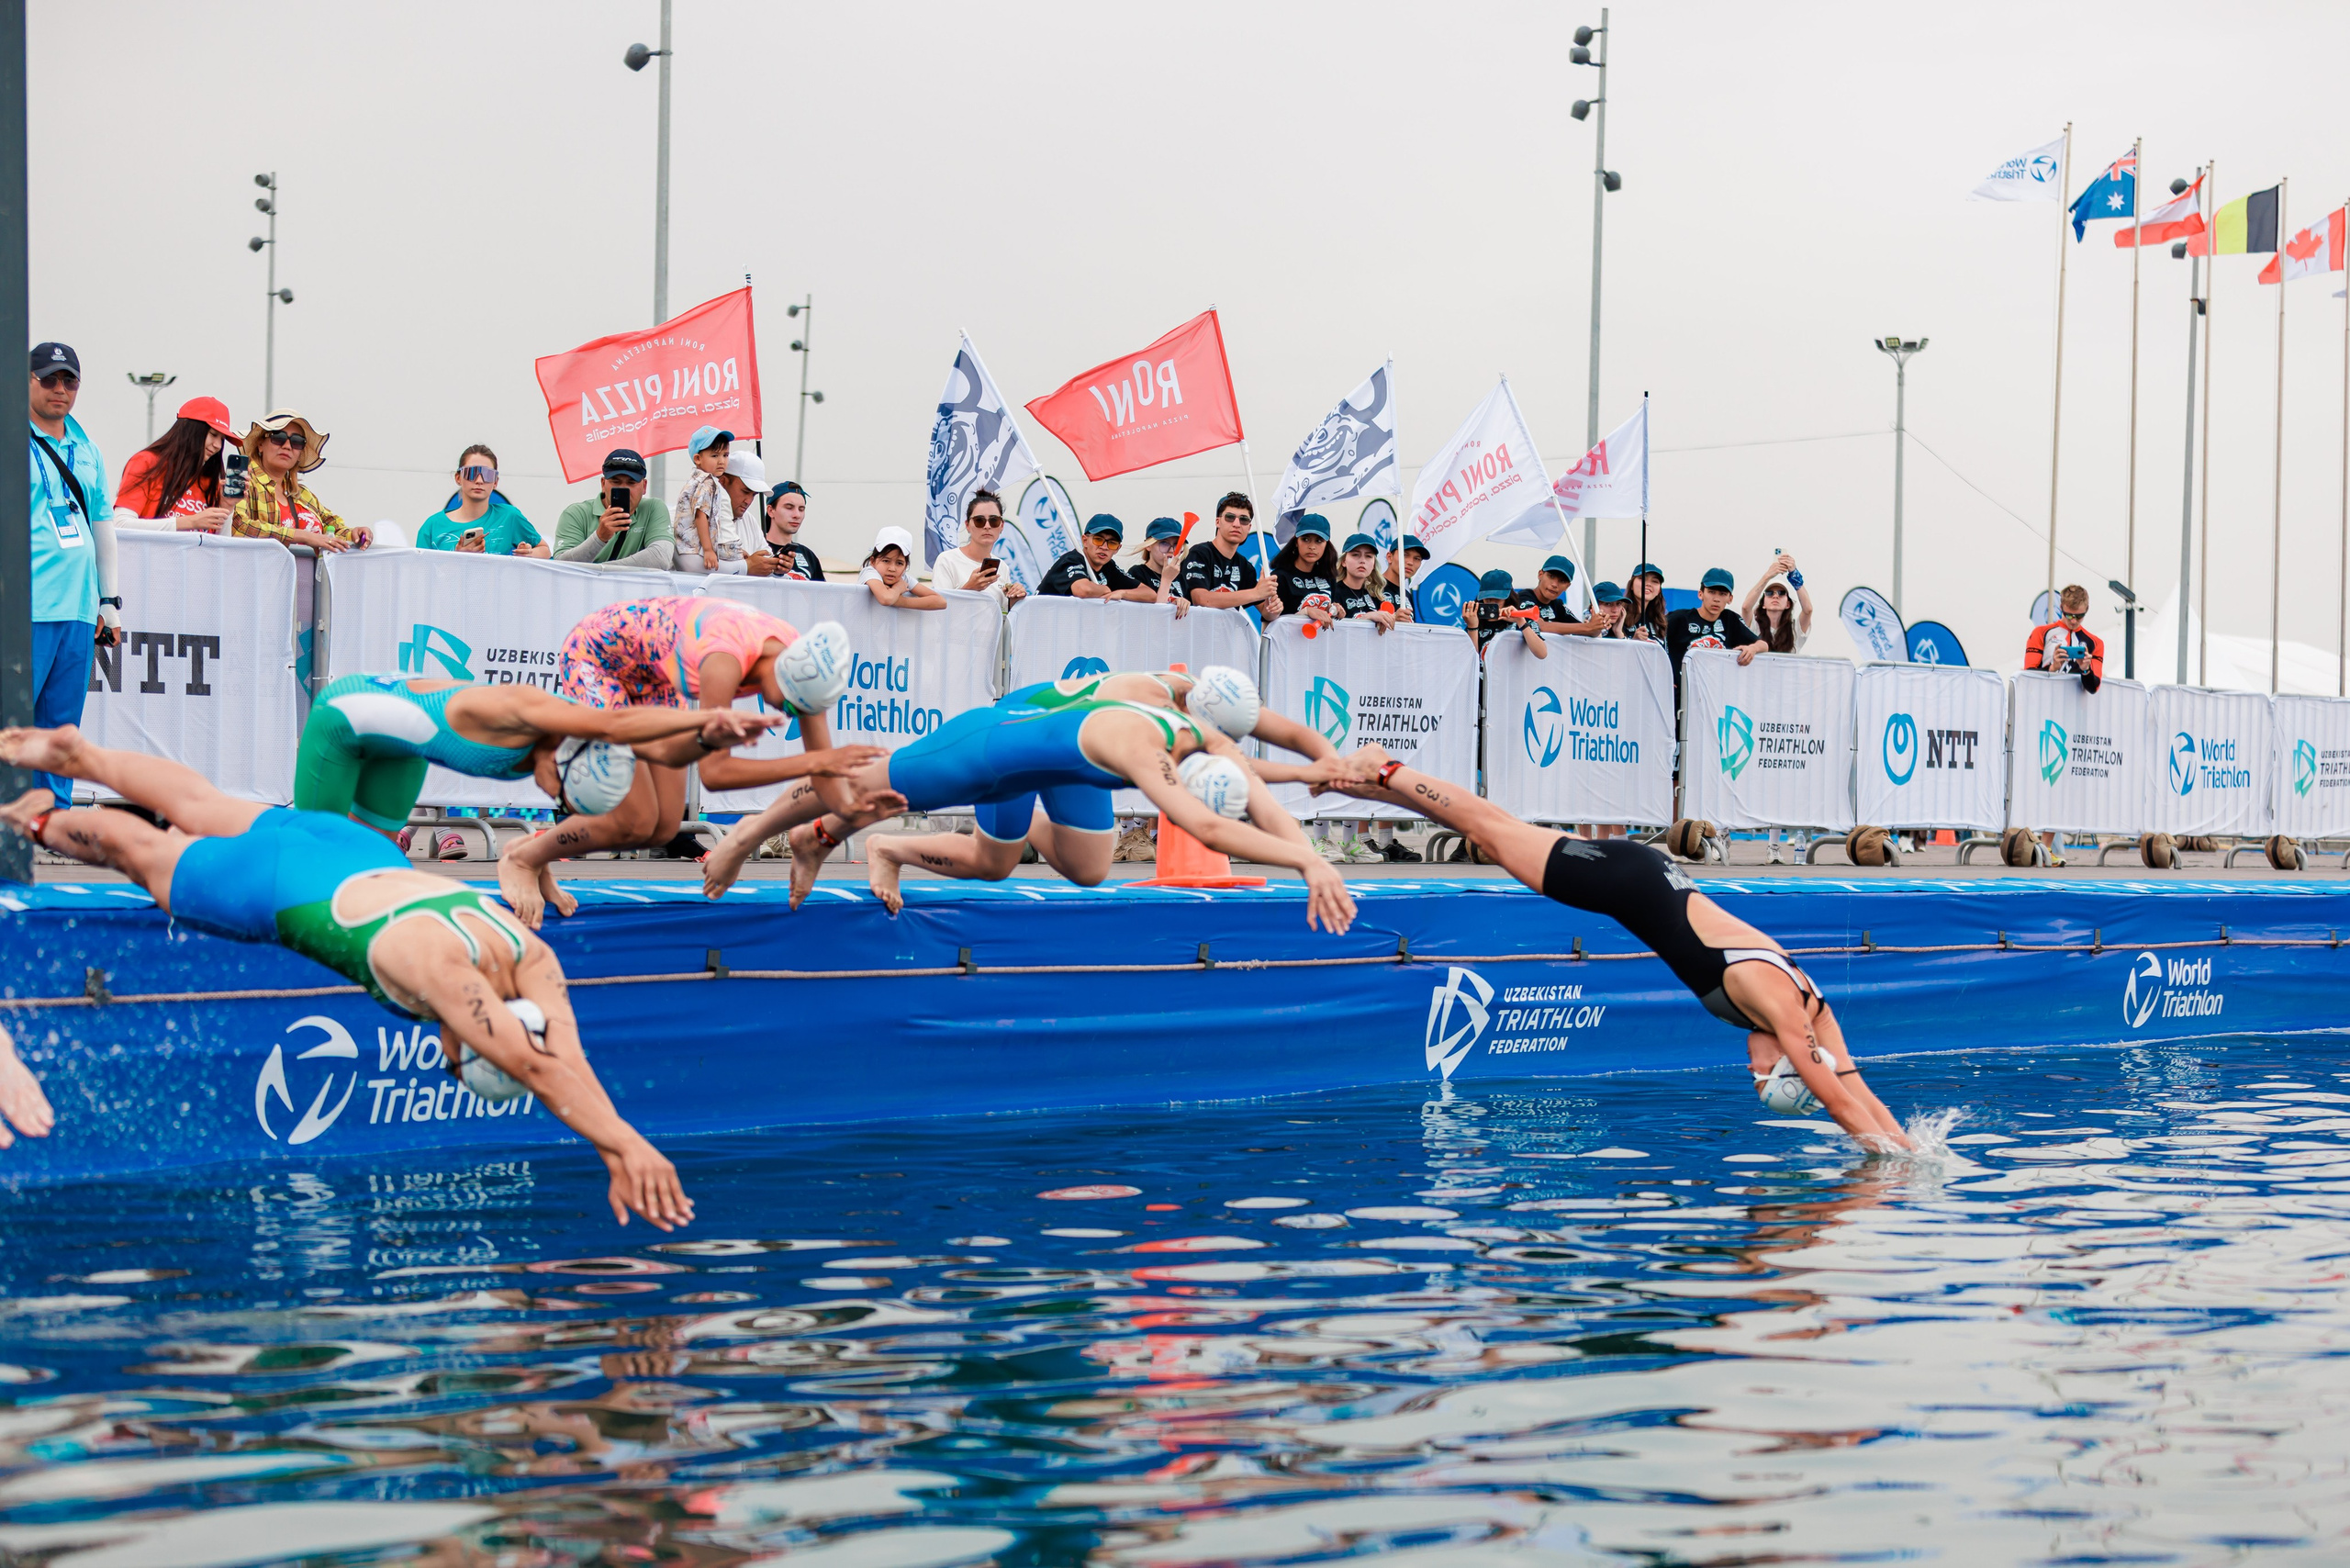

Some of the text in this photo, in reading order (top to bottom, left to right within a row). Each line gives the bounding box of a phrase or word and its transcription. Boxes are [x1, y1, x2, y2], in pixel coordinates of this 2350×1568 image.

[87, 631, 220, 696] NTT
[487, 648, 561, 666] UZBEKIS
[1359, 696, 1423, 709] UZBEKISTAN
[1569, 697, 1618, 729] World
[1760, 722, 1810, 734] UZBEKISTAN
[1568, 731, 1639, 764] Triathlon
[1759, 737, 1825, 755] TRIATHLON
[1927, 729, 1978, 769] NTT
[2073, 734, 2112, 746] UZBEKISTAN
[2072, 747, 2123, 766] TRIATHLON
[2200, 738, 2235, 762] World
[1758, 758, 1806, 769] FEDERATION
[2071, 767, 2109, 778] FEDERATION
[2200, 766, 2250, 789] Triathlon
[2167, 958, 2211, 987] World
[1504, 984, 1583, 1002] UZBEKISTAN
[2161, 989, 2223, 1018] Triathlon
[1495, 1005, 1606, 1032] TRIATHLON
[1488, 1036, 1568, 1054] FEDERATION
